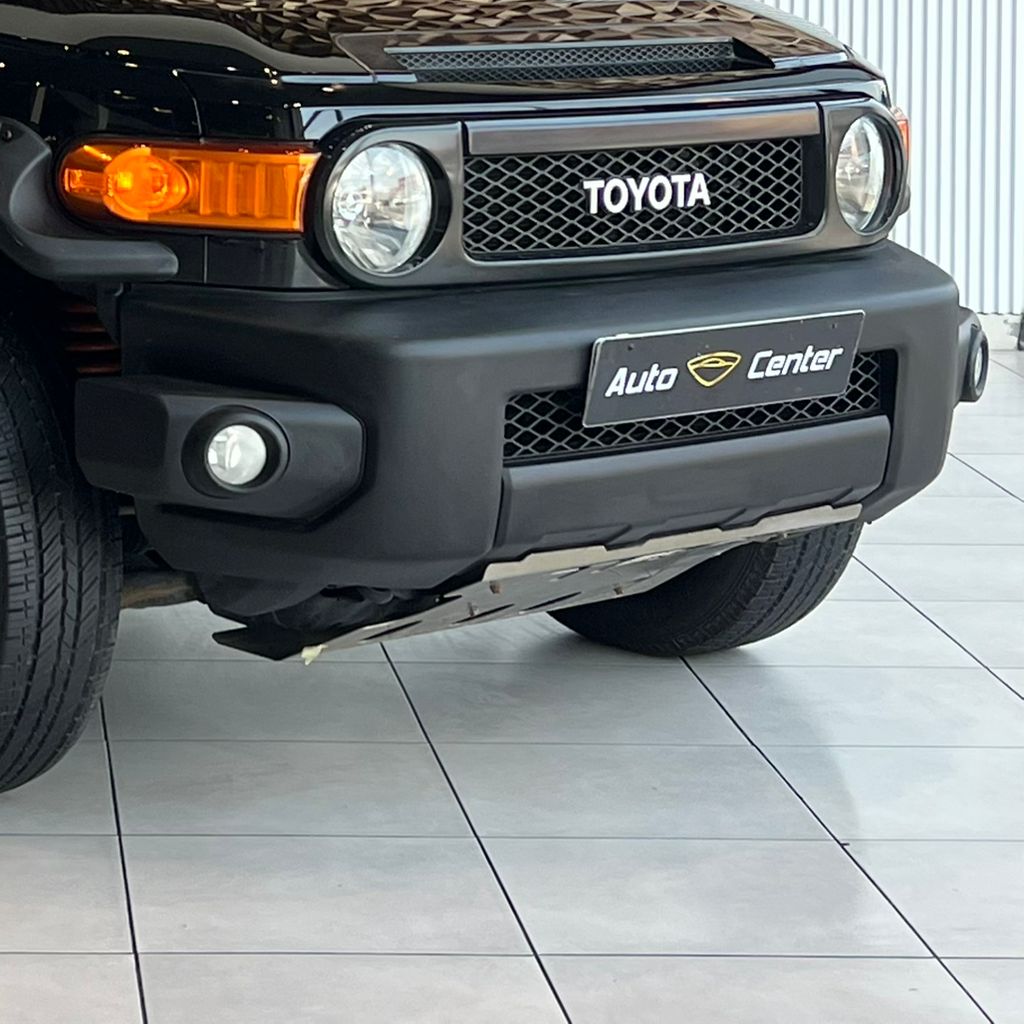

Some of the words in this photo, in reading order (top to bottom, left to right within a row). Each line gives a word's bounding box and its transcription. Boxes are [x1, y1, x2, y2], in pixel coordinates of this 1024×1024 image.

[582, 172, 712, 215] TOYOTA
[604, 362, 679, 398] Auto
[746, 344, 844, 380] Center
